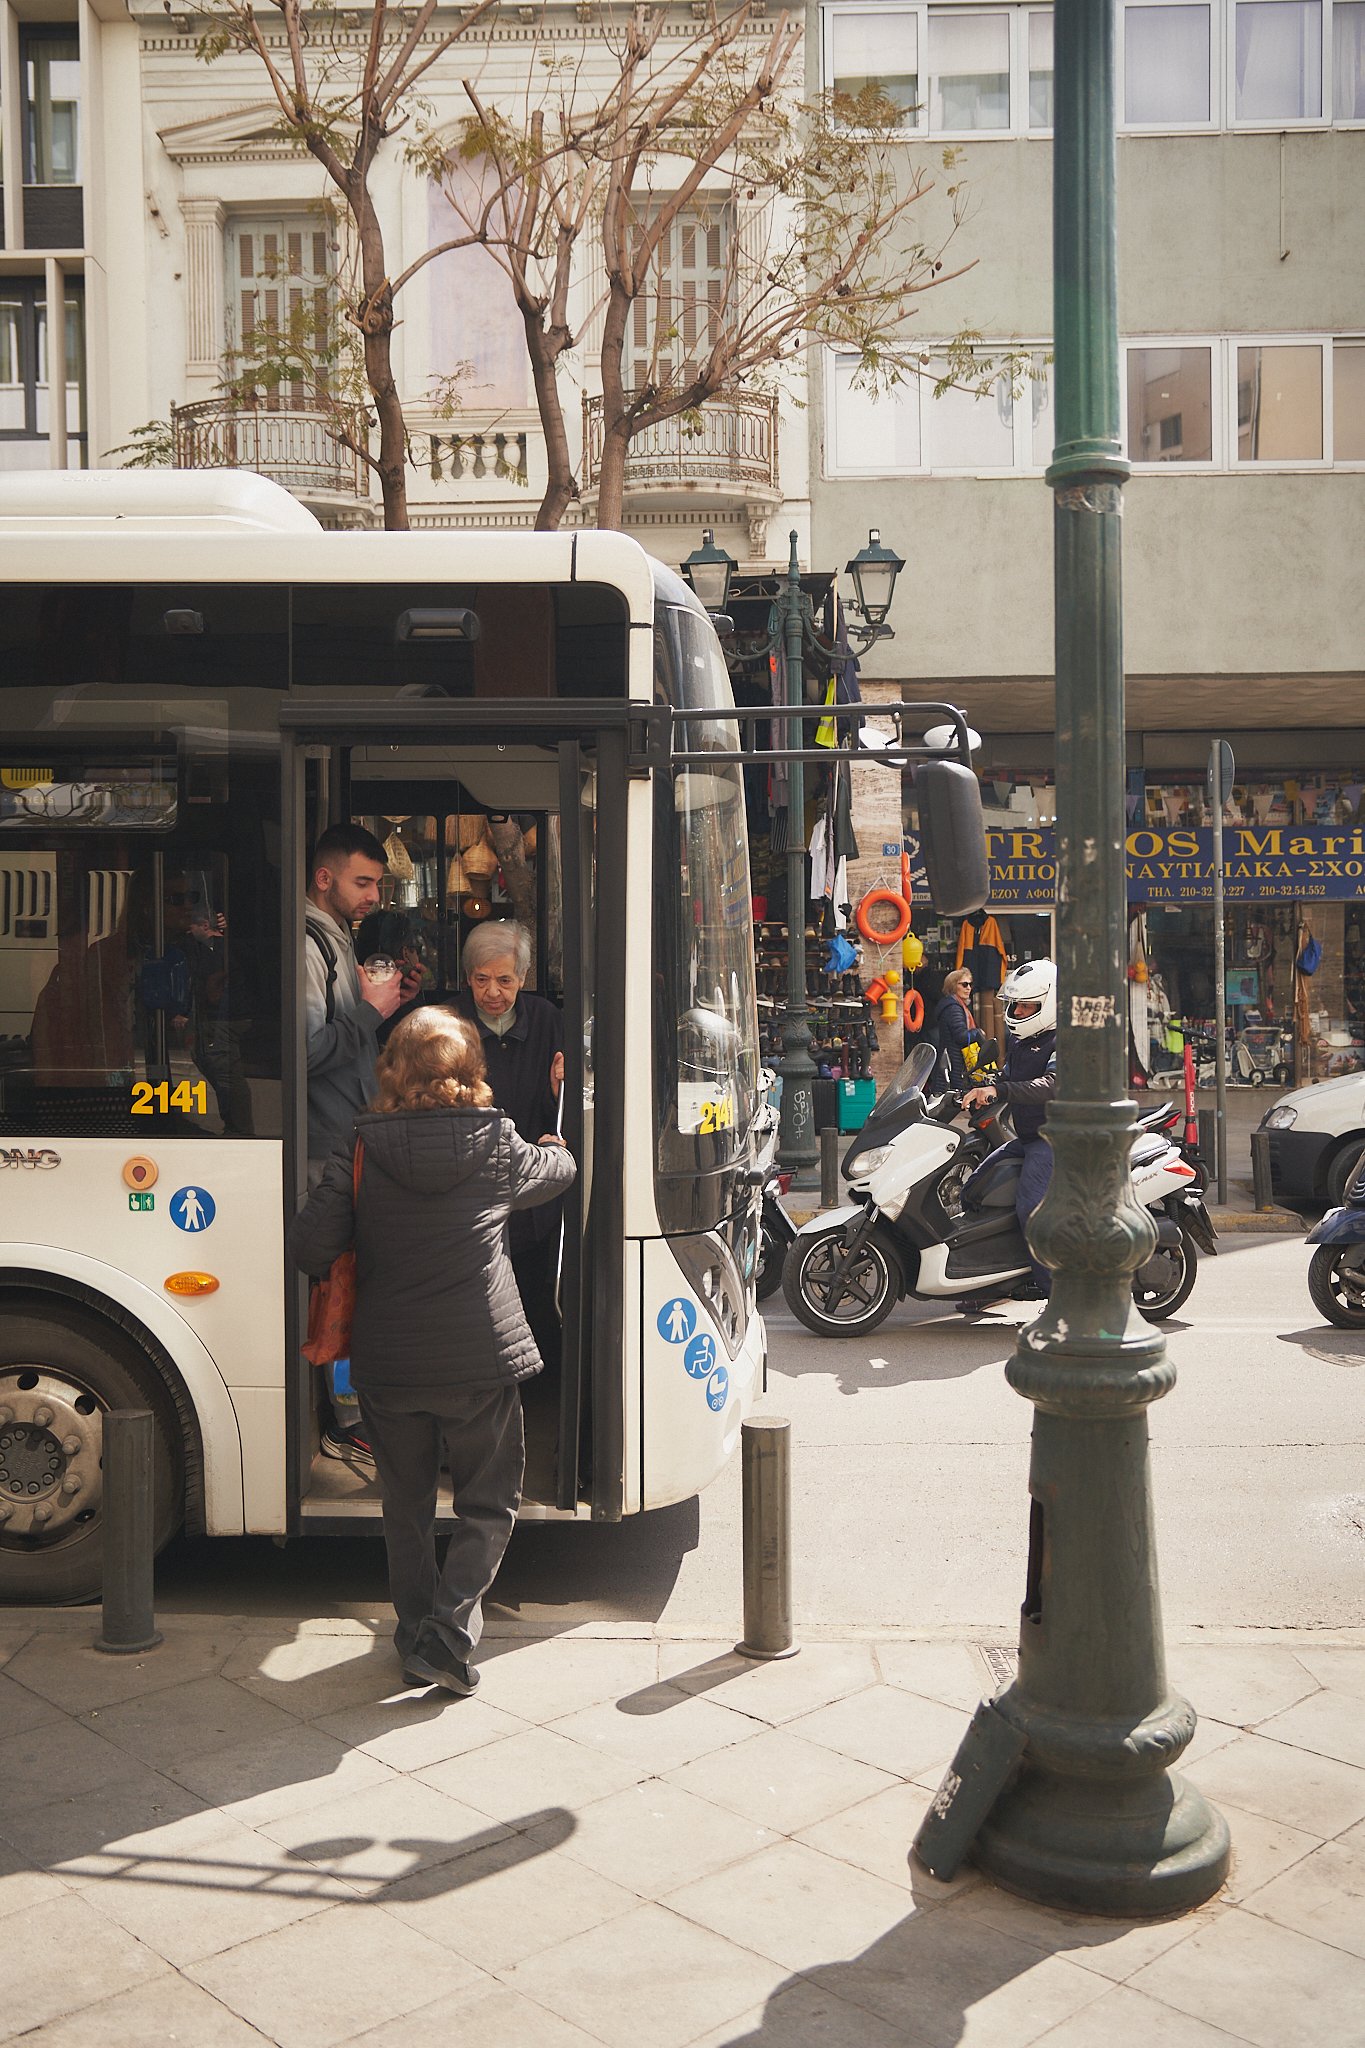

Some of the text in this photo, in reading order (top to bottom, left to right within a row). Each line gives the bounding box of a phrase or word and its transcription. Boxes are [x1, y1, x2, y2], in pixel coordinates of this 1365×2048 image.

[886, 845, 896, 855] 30
[1234, 828, 1365, 856] Mari
[991, 888, 1019, 899] ΕΖΟΥ
[1260, 885, 1326, 896] 210-32.54.552
[131, 1080, 207, 1115] 2141
[700, 1096, 733, 1134] 2141
